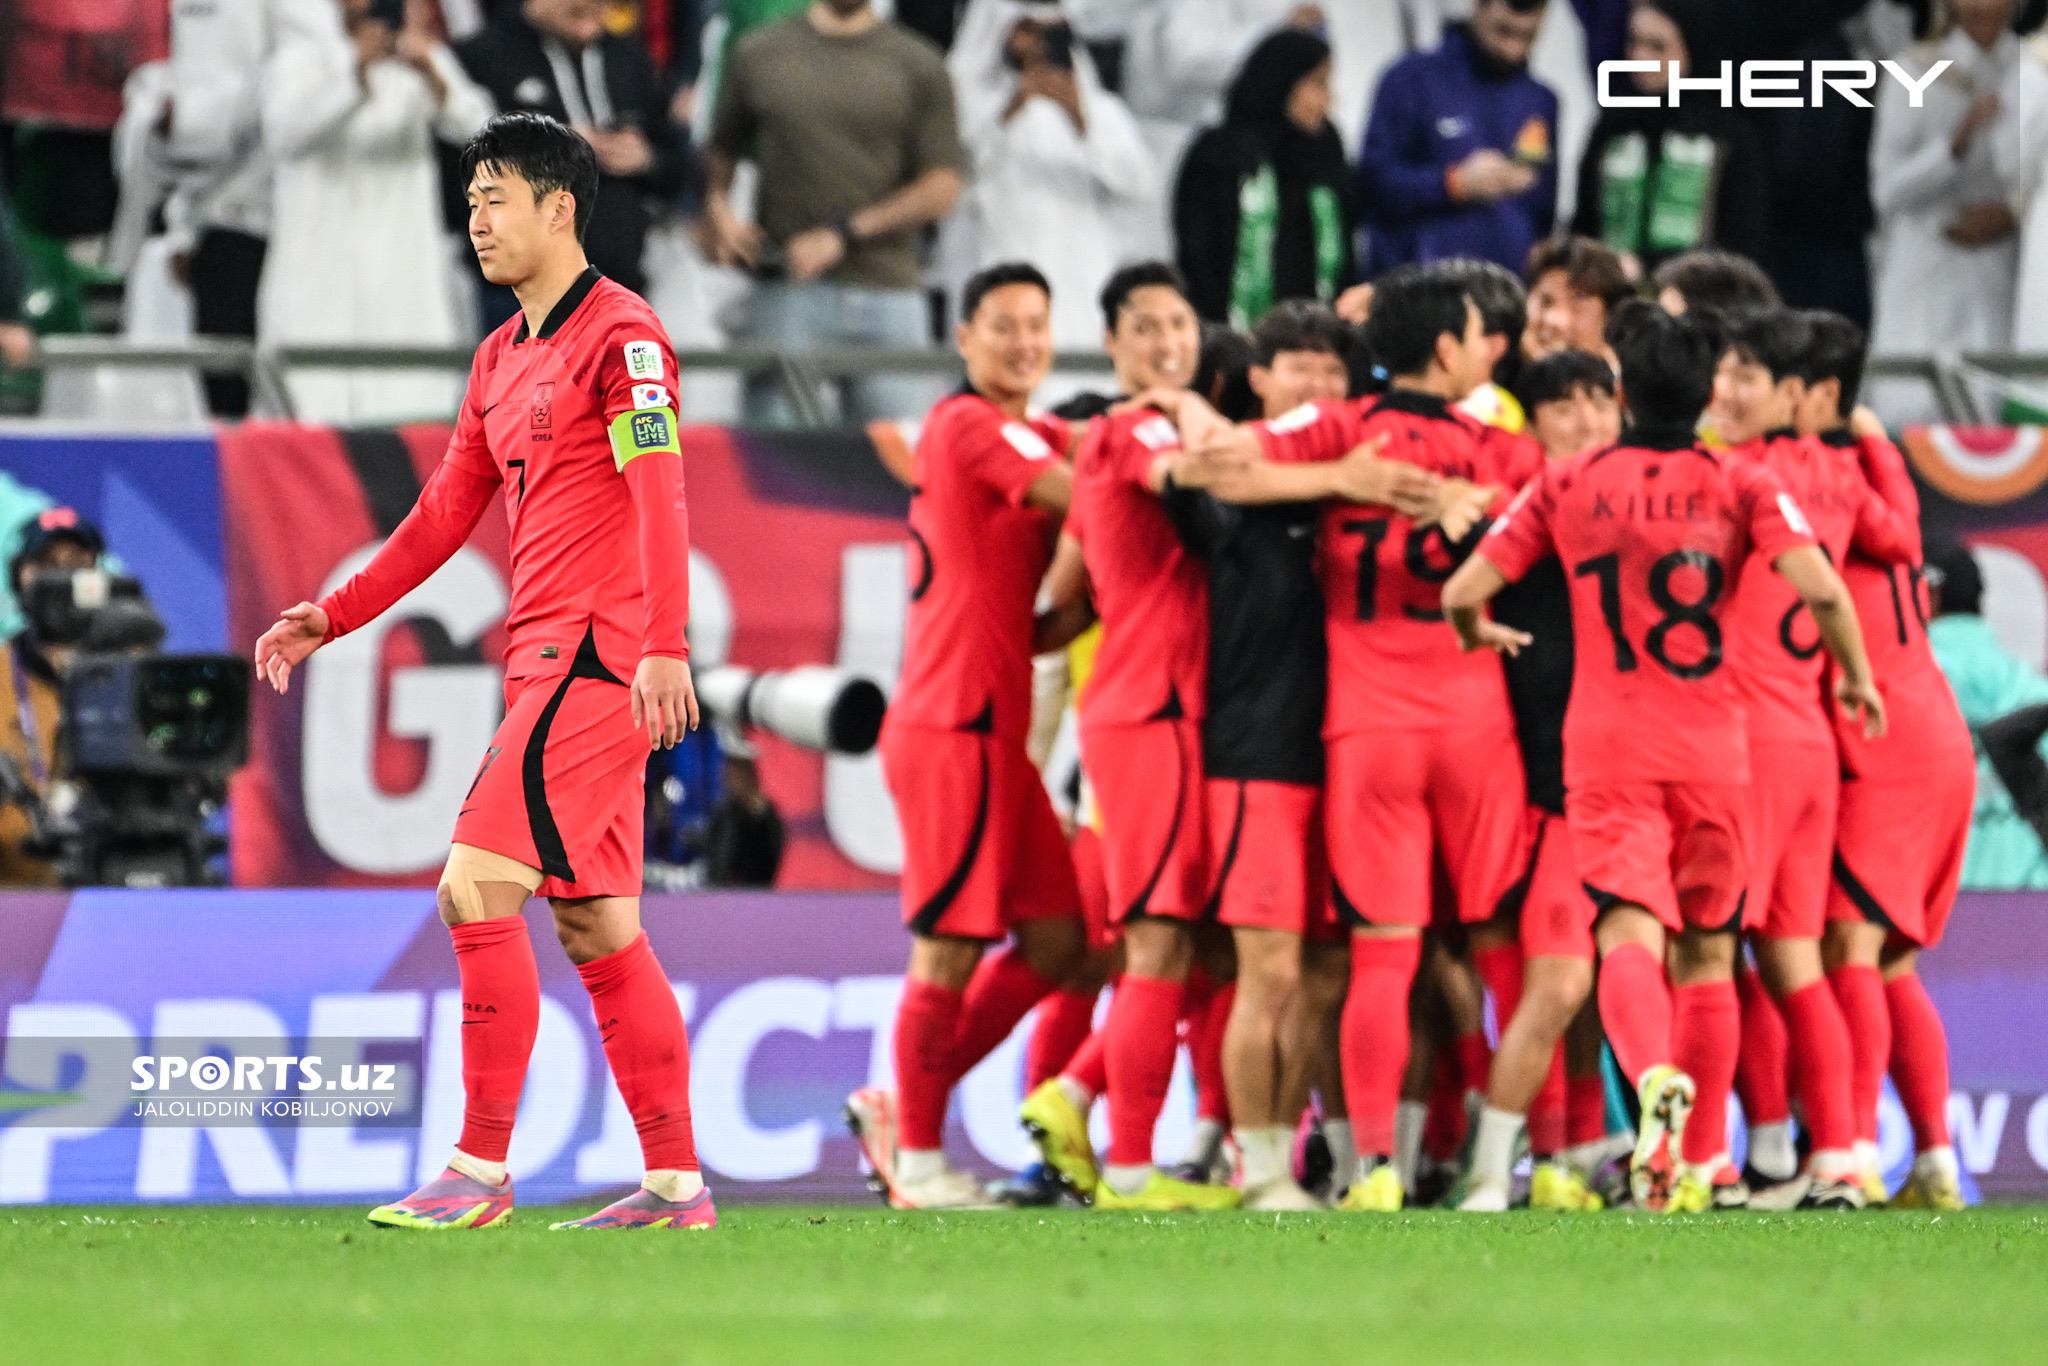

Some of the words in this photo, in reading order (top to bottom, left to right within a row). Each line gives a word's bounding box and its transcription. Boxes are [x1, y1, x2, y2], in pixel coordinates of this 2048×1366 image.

[632, 354, 658, 365] LIVE
[635, 415, 653, 425] AFC
[636, 423, 666, 435] LIVE
[531, 433, 554, 442] KOREA
[506, 459, 526, 509] 7
[1575, 549, 1724, 680] 18
